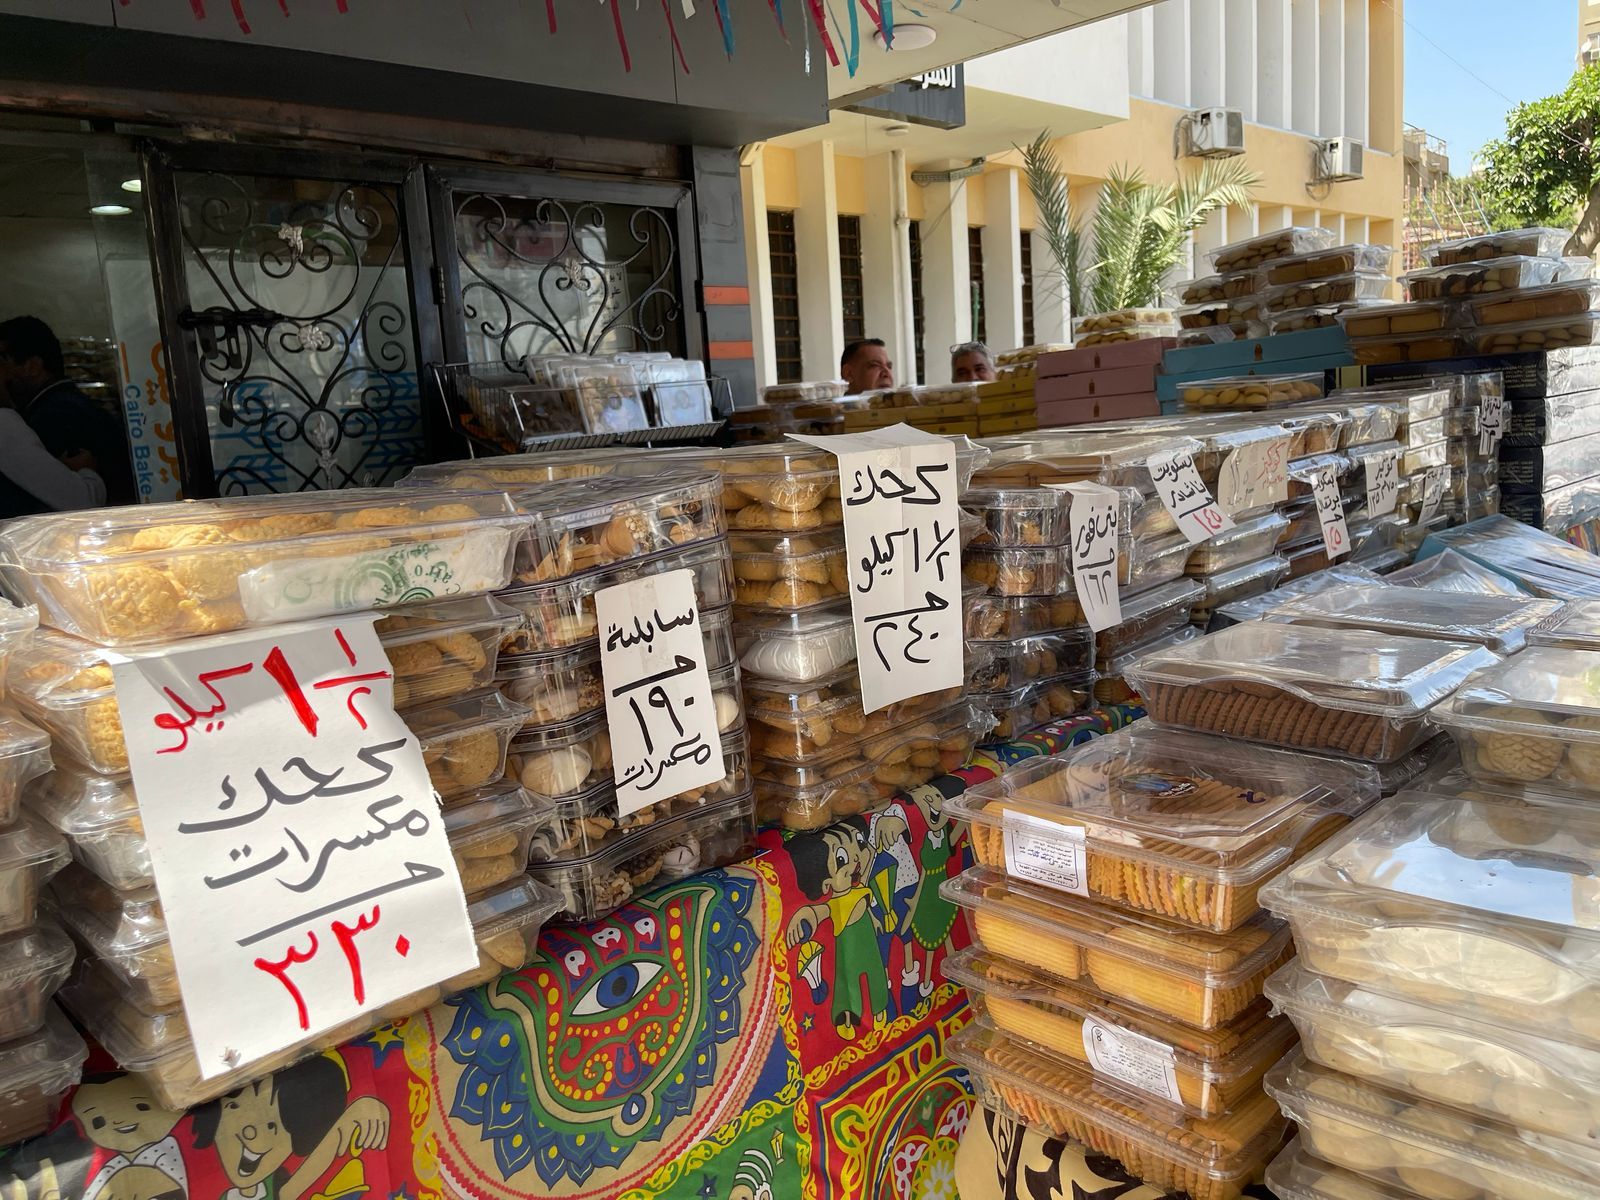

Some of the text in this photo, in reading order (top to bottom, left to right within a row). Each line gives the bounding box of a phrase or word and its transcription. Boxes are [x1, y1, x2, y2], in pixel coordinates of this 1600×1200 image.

[125, 385, 153, 495] Cairo Bake
[846, 463, 949, 506] كحك
[857, 527, 910, 593] كيلو
[872, 614, 940, 672] ٢٤٠
[153, 662, 253, 754] كيلو
[629, 685, 695, 756] ١٩٠
[178, 737, 408, 835] كحك
[616, 732, 712, 791] مكسرات
[203, 794, 431, 893] مكسرات
[253, 904, 411, 1031] ٣٣٠
